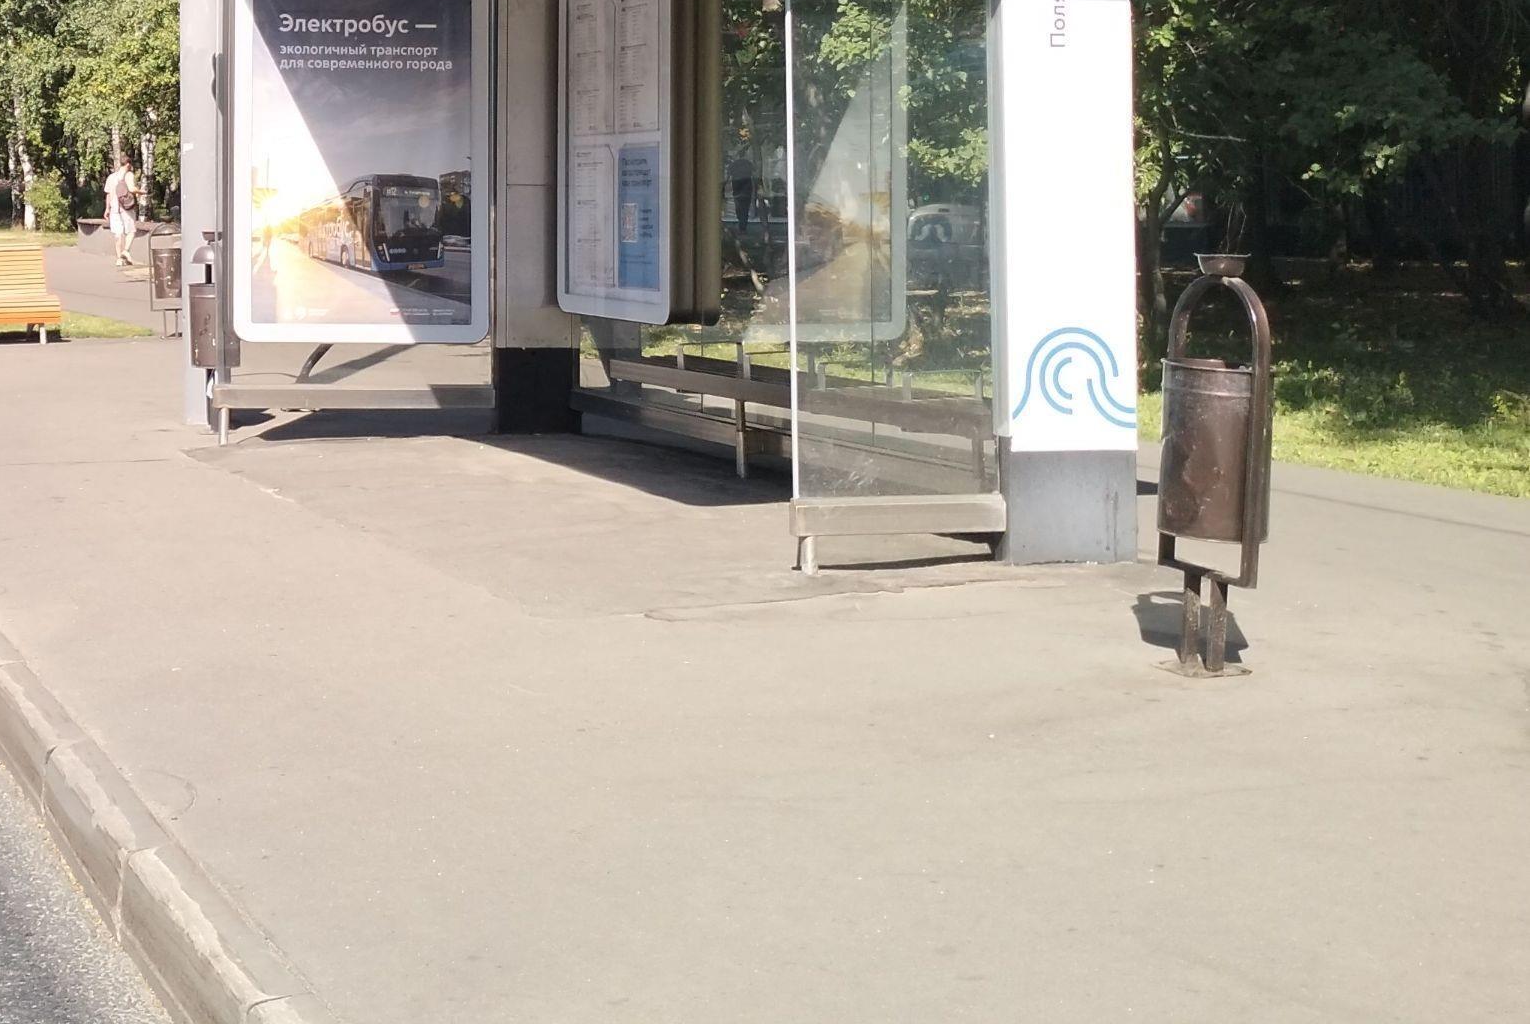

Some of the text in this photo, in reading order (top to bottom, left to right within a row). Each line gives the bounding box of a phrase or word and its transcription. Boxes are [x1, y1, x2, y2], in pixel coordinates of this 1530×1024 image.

[278, 13, 409, 38] Электробус
[279, 44, 438, 57] экологичный транспорт
[279, 59, 453, 71] для современного города
